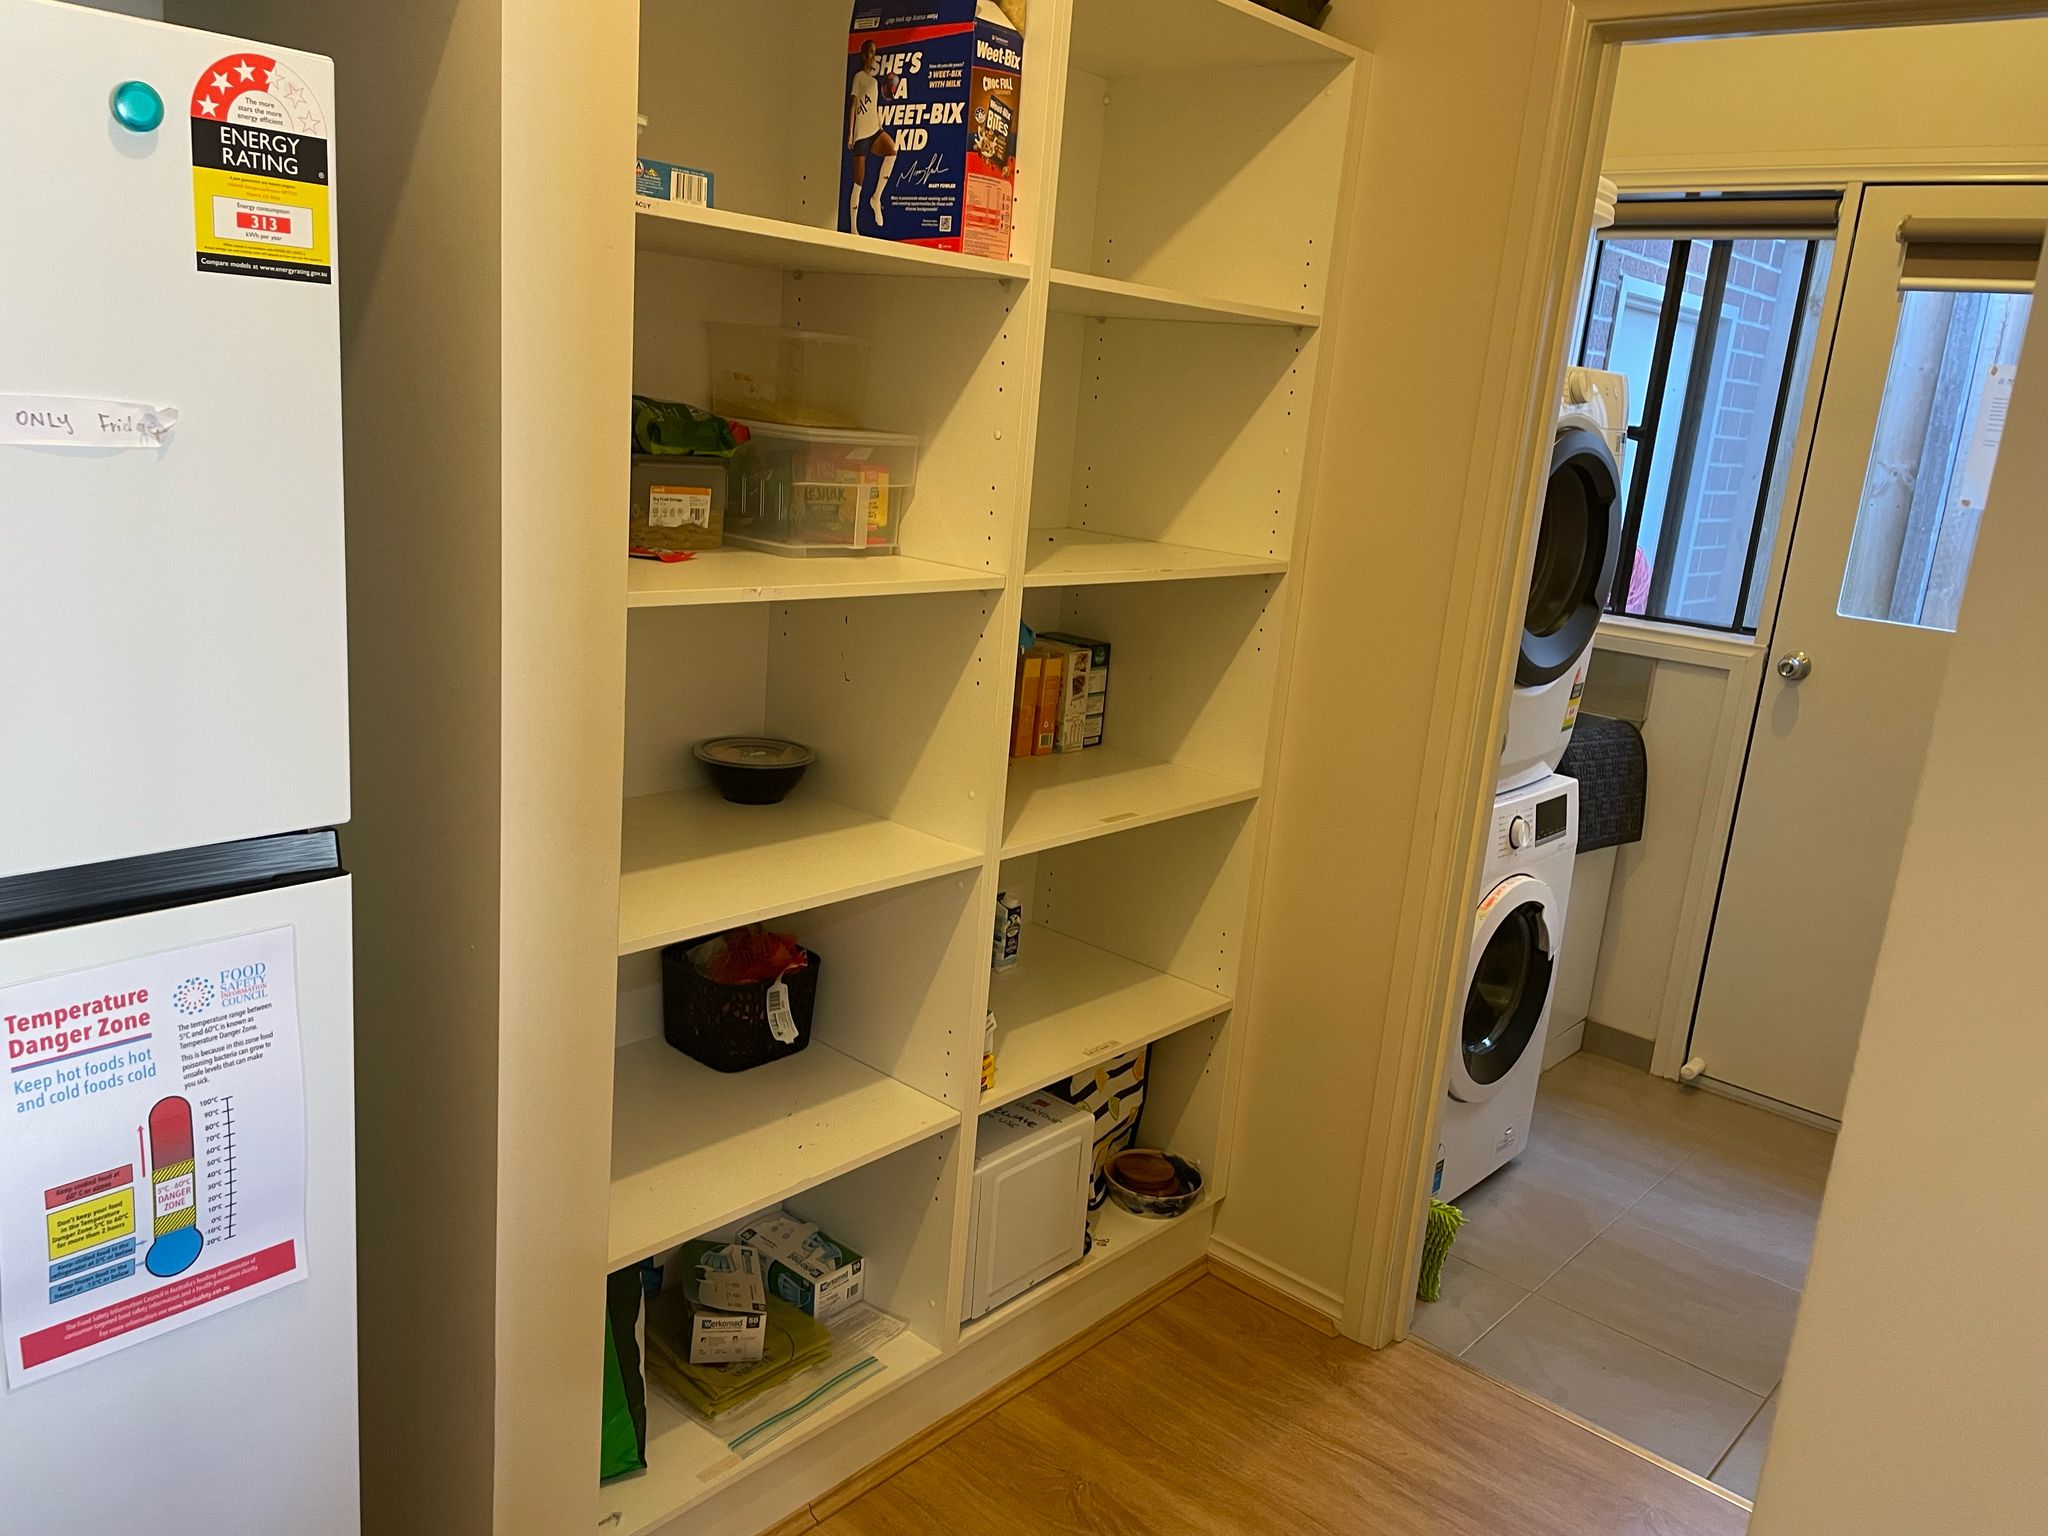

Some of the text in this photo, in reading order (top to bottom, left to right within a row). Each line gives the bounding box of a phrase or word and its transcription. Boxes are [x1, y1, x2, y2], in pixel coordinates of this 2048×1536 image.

[976, 40, 1021, 70] Weet-Bix
[934, 70, 962, 78] WEET-BIX
[893, 77, 908, 99] A
[982, 76, 1000, 92] CHOC
[1000, 77, 1014, 90] FULL
[245, 97, 275, 108] The more
[238, 113, 284, 126] energy efficient
[266, 110, 282, 118] more
[878, 102, 966, 126] WEET-BIX
[220, 126, 300, 155] ENERGY
[895, 128, 928, 151] KID
[222, 147, 298, 174] RATING
[236, 202, 290, 214] Energy consumption
[251, 215, 278, 231] 313
[200, 257, 229, 267] Compare
[230, 262, 252, 270] models
[16, 410, 74, 435] ONLY
[220, 962, 266, 984] FOOD
[220, 974, 266, 992] SAFETY
[221, 984, 267, 999] INFORMATION
[222, 990, 268, 1008] COUNCIL
[4, 989, 149, 1034] Temperature
[191, 1015, 227, 1028] temperature
[229, 1010, 246, 1018] range
[247, 1003, 272, 1013] between
[8, 1012, 150, 1059] Danger Zone
[180, 1032, 190, 1040] 5°C
[192, 1028, 203, 1037] and
[205, 1024, 219, 1034] 60°C
[227, 1019, 246, 1028] known
[180, 1036, 218, 1049] Temperature
[220, 1030, 241, 1039] Danger
[201, 1046, 225, 1056] because
[234, 1040, 244, 1048] this
[261, 1032, 273, 1040] food
[183, 1058, 212, 1071] poisoning
[214, 1051, 237, 1062] bacteria
[250, 1045, 264, 1054] grow
[184, 1069, 203, 1079] unsafe
[205, 1064, 222, 1073] levels
[223, 1060, 234, 1068] that
[247, 1053, 263, 1062] make
[14, 1048, 152, 1095] Keep hot foods hot
[16, 1062, 156, 1113] and cold foods cold
[184, 1076, 210, 1089] you sick.
[200, 1096, 218, 1107] 100°C
[204, 1108, 219, 1118] 90°C
[205, 1122, 220, 1132] 80°C
[206, 1134, 220, 1142] 70°C
[206, 1145, 221, 1154] 60°C
[207, 1157, 222, 1167] 50°C
[207, 1169, 222, 1178] 40°C
[57, 1187, 72, 1195] Keep
[98, 1174, 112, 1182] food
[158, 1178, 191, 1194] 5°C 60°C
[208, 1181, 222, 1190] 30°C
[158, 1186, 191, 1204] DANGER
[208, 1193, 222, 1202] 20°C
[164, 1198, 186, 1211] ZONE
[208, 1204, 222, 1213] 10°C
[57, 1217, 74, 1227] Don't
[93, 1207, 107, 1216] your
[109, 1201, 122, 1210] food
[81, 1211, 120, 1226] Temperature
[211, 1216, 222, 1224] 0°C
[52, 1232, 75, 1243] Danger
[114, 1214, 128, 1223] 60°C
[68, 1236, 84, 1245] more
[86, 1231, 100, 1239] than
[107, 1223, 124, 1232] hours
[58, 1262, 73, 1270] Keep
[58, 1283, 73, 1291] Keep
[702, 1320, 743, 1329] Werkomed
